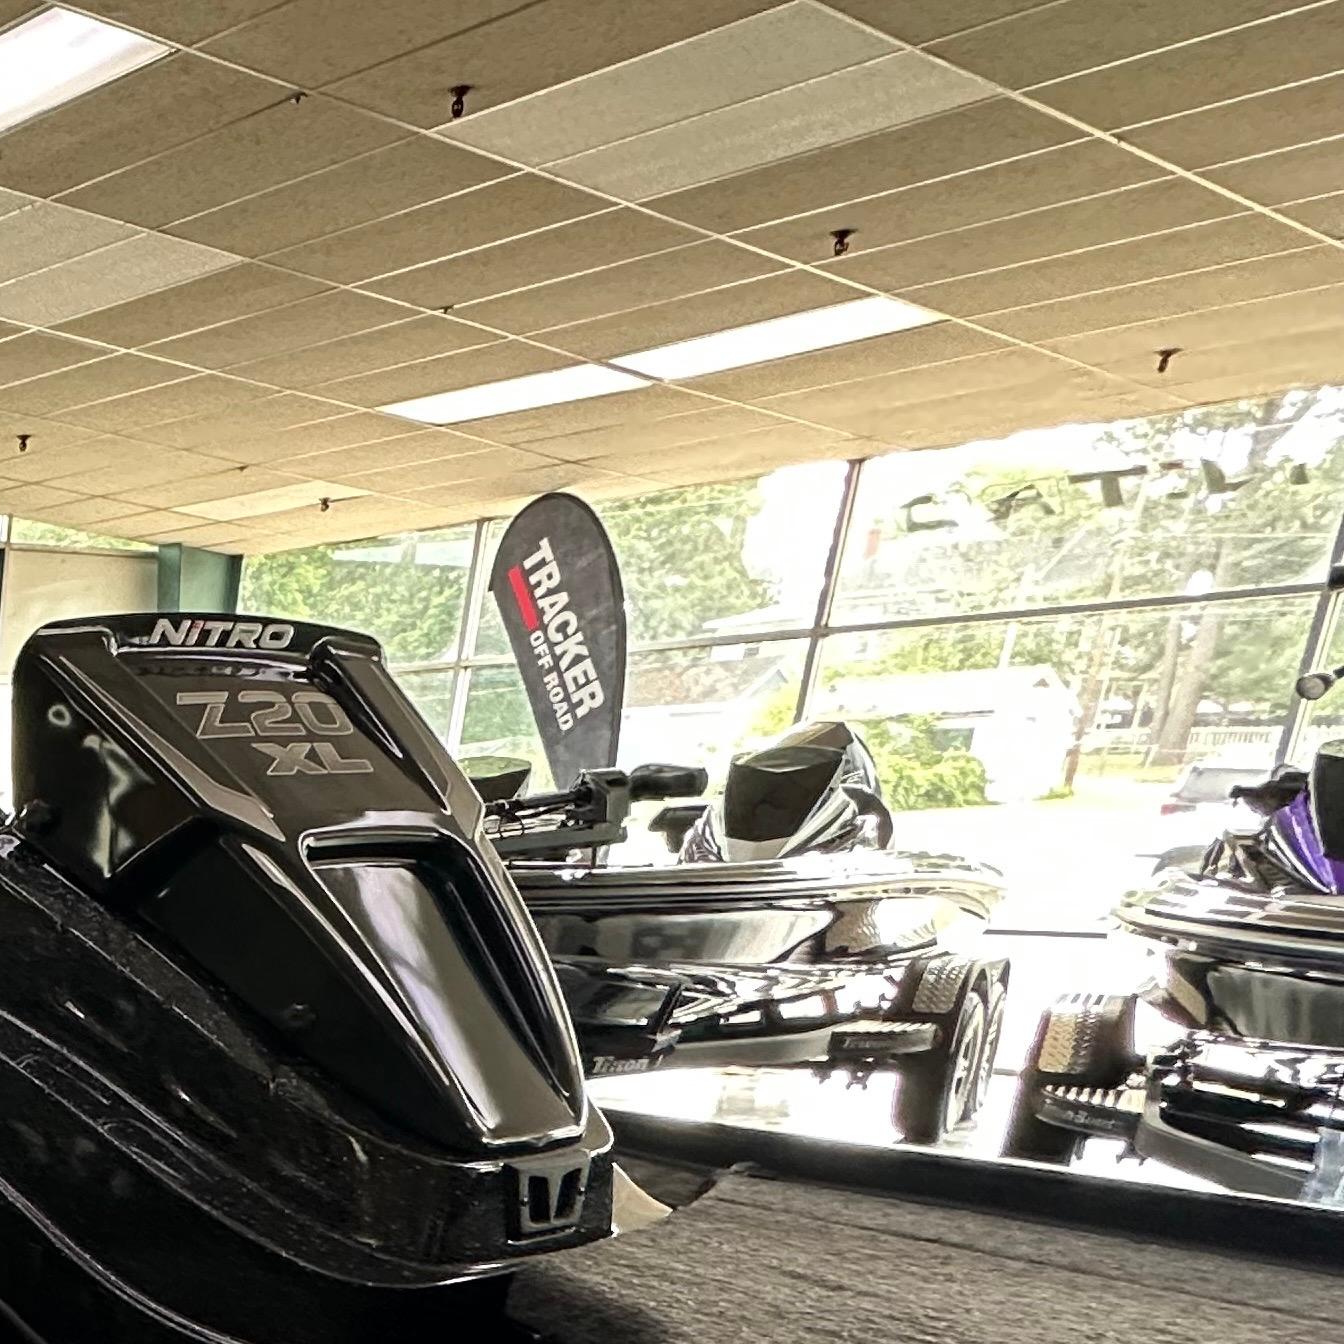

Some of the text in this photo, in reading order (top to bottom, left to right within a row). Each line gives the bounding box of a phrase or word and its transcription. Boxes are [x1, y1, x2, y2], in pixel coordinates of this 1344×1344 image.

[149, 618, 295, 649] NITRO
[522, 537, 605, 720] TRACKER
[530, 630, 574, 731] OFF ROAD
[176, 690, 354, 739] Z20
[250, 742, 374, 776] XL
